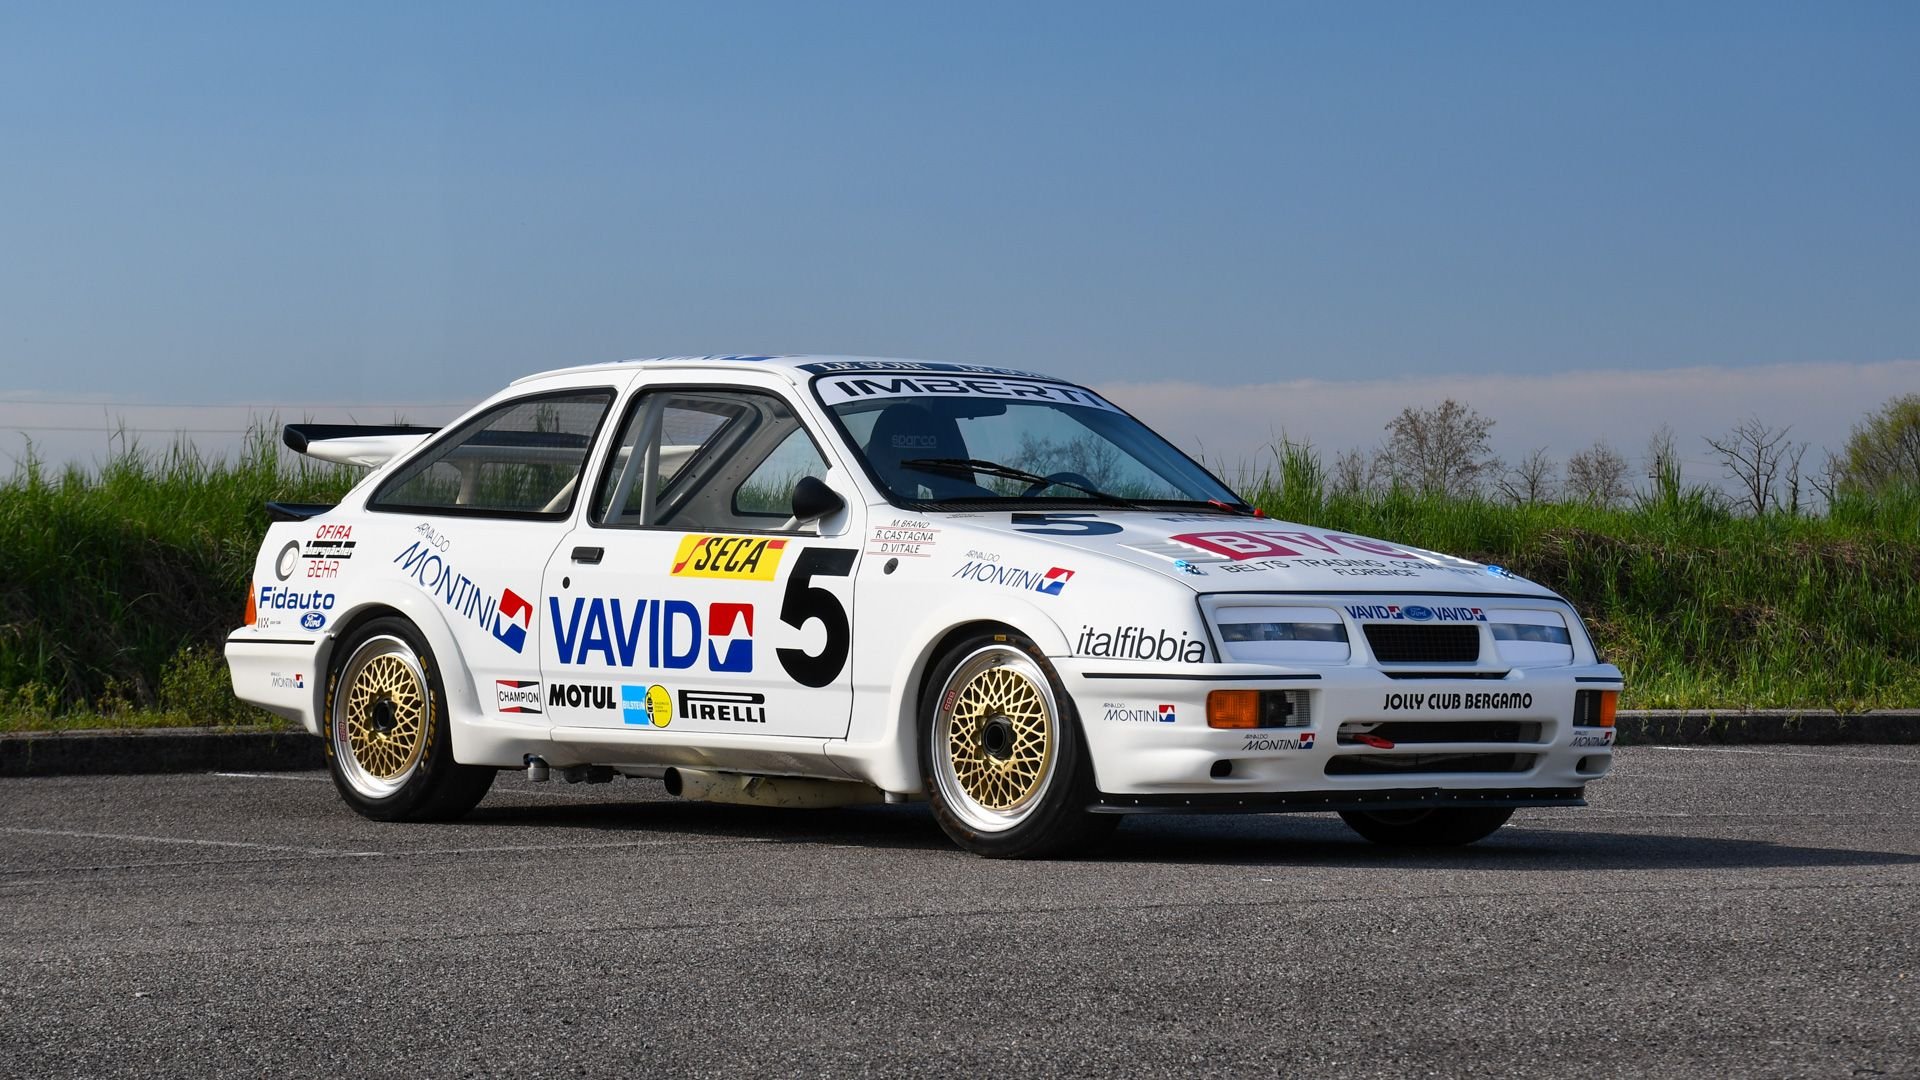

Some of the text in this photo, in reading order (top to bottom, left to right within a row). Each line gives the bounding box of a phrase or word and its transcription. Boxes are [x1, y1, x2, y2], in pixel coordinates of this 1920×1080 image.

[834, 378, 1103, 408] IMBERTI
[891, 434, 937, 447] sparco
[316, 524, 353, 540] OFIRA
[901, 519, 931, 529] BRAND
[1011, 513, 1123, 536] 5
[415, 522, 451, 553] ARNALDO
[884, 530, 934, 541] CASTAGNA
[694, 537, 770, 574] SECA
[891, 543, 921, 553] VITALE
[966, 549, 1001, 562] ARNALDO
[307, 560, 340, 578] BEHR
[1219, 560, 1290, 573] BELTS
[1291, 559, 1387, 568] TRADING
[1331, 568, 1421, 578] FLORENCE
[952, 561, 1043, 591] MONTINI
[393, 540, 497, 632] MONTINI
[259, 586, 336, 610] Fidauto
[303, 613, 323, 629] Ford
[776, 546, 860, 689] 5
[1344, 605, 1390, 619] VAVID
[1431, 607, 1474, 621] VAVID
[548, 596, 702, 669] VAVID
[1076, 624, 1206, 664] italfibbia
[499, 691, 539, 703] CHAMPION
[549, 683, 617, 710] MOTUL
[1383, 692, 1533, 710] JOLLY CLUB BERGAMO
[678, 690, 766, 723] PIRELLI
[1104, 709, 1158, 722] MONTINI
[1241, 739, 1299, 751] MONTINI
